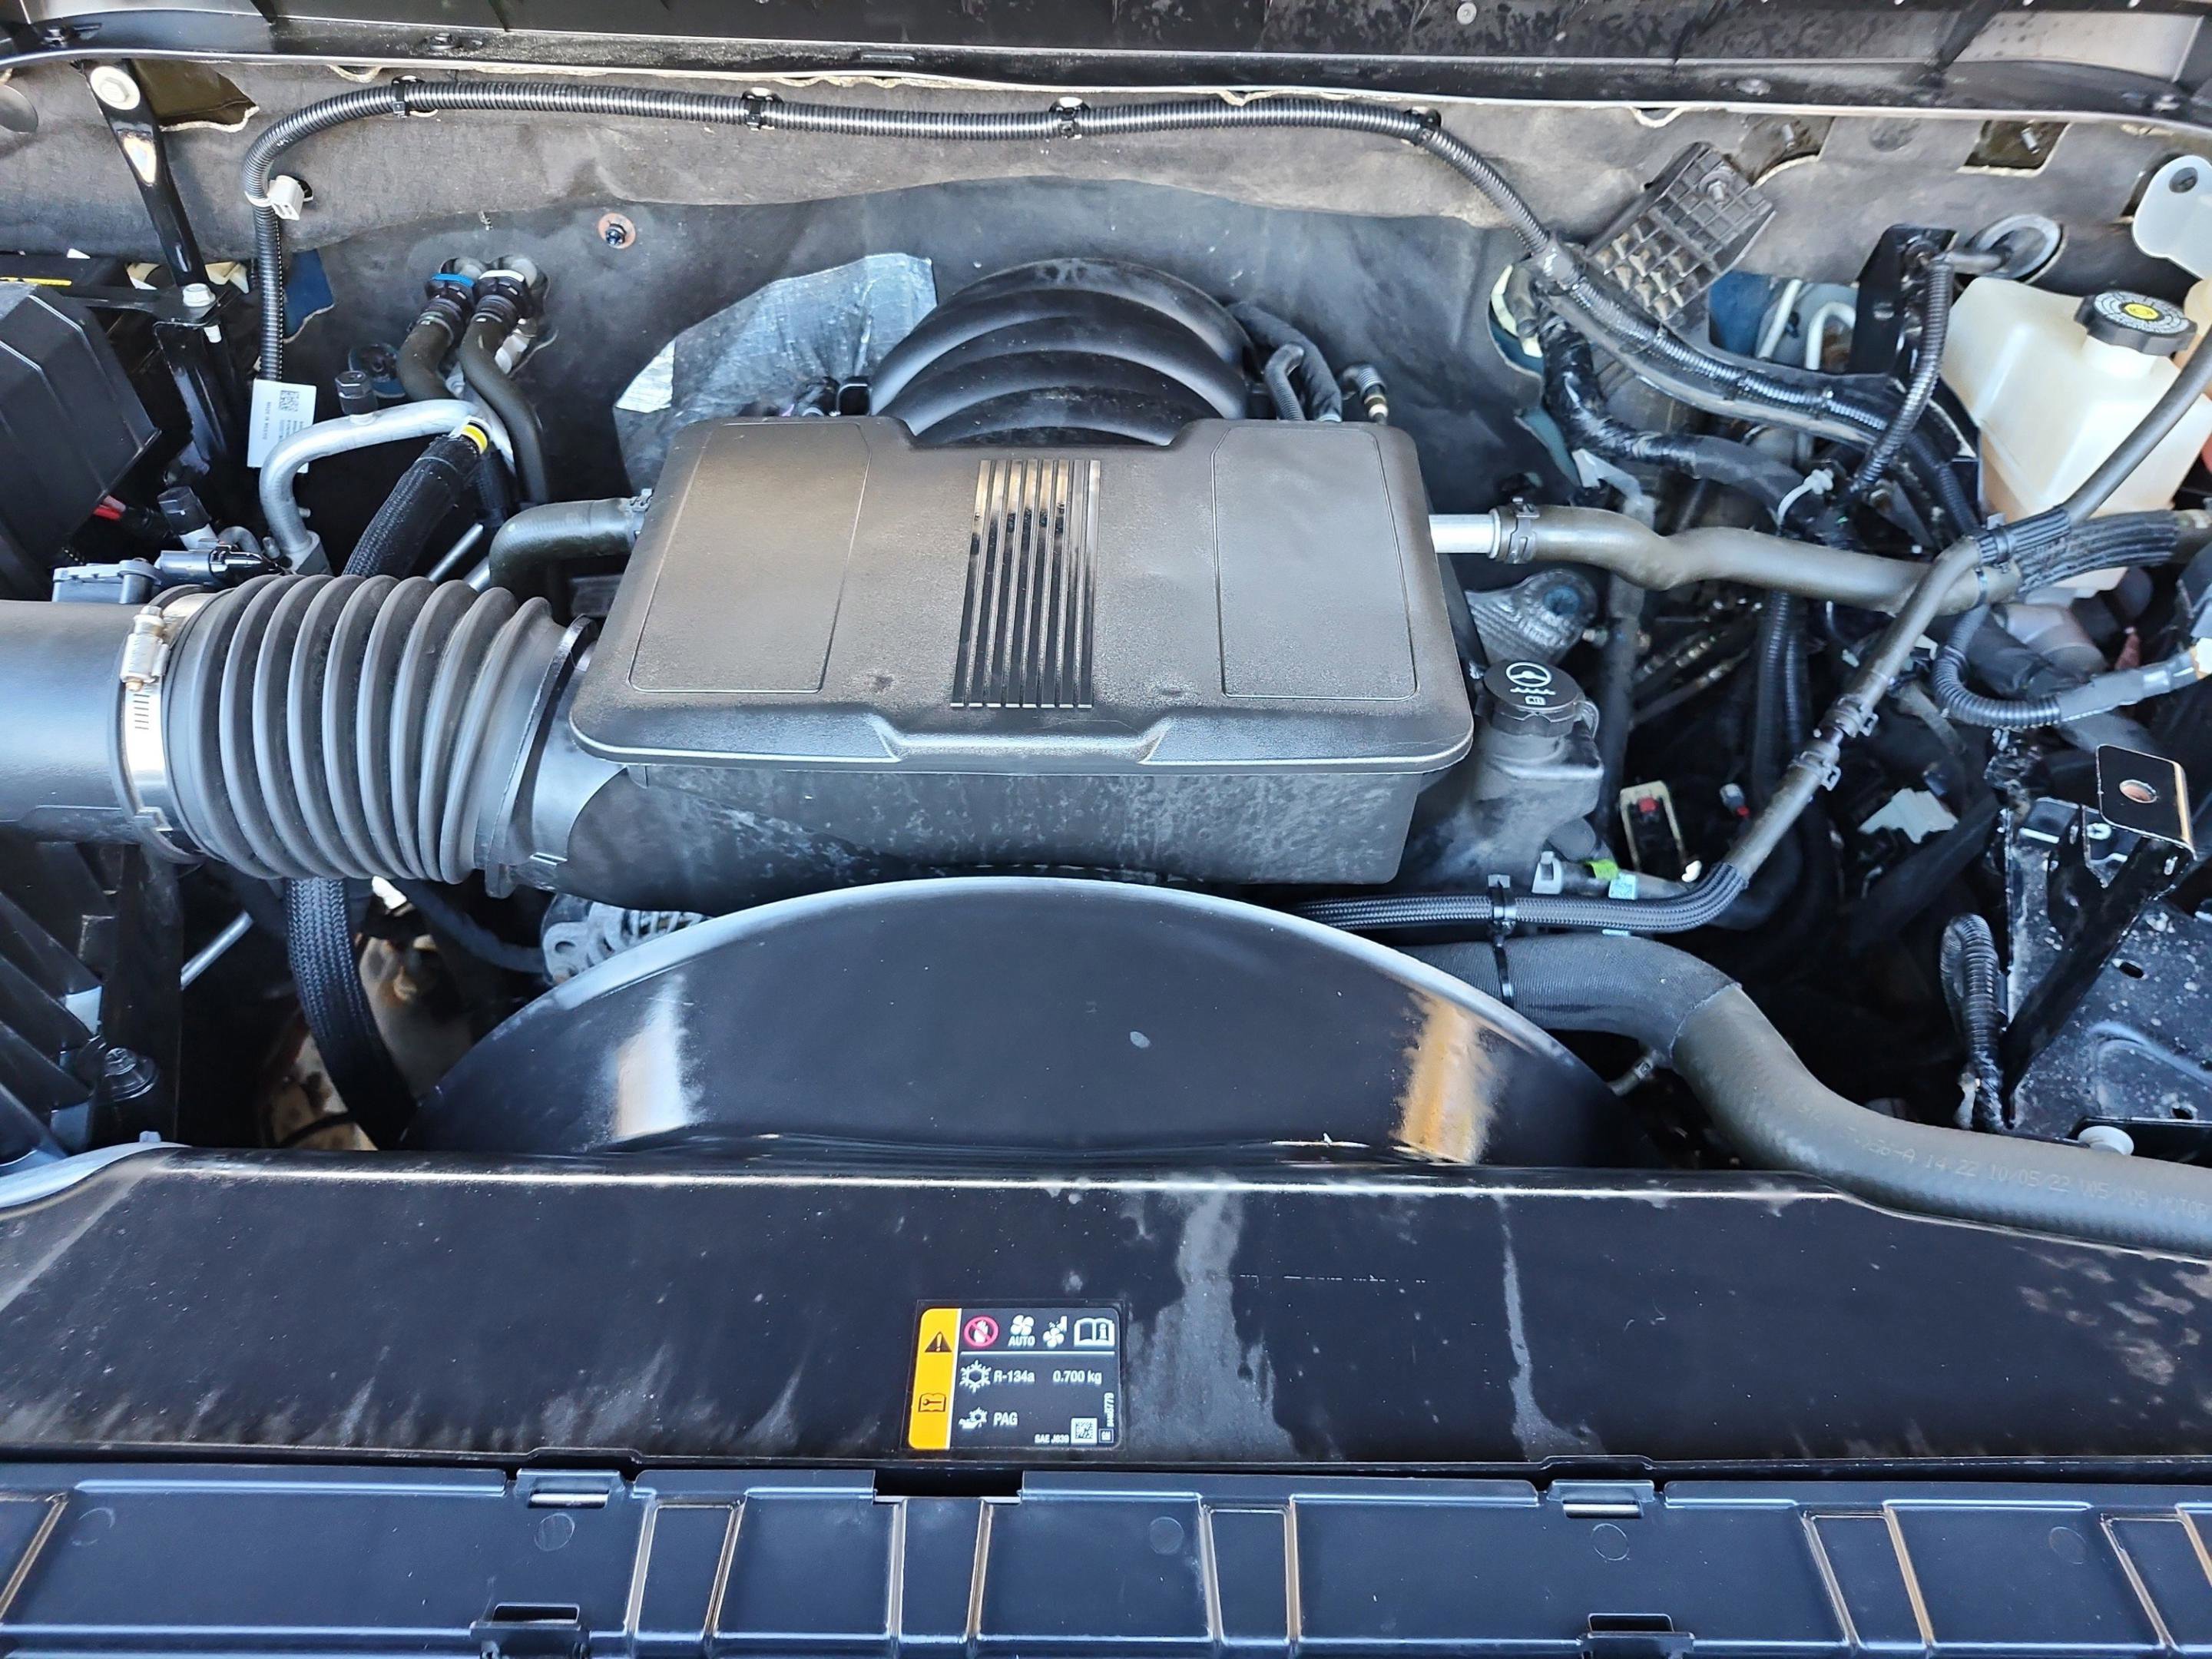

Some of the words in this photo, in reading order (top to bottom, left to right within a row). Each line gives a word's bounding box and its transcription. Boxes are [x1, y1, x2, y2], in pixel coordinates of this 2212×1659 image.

[1008, 1336, 1035, 1346] AUTO
[994, 1370, 1035, 1383] R-134a
[1052, 1370, 1085, 1383] 0.700
[1087, 1370, 1102, 1385] kg
[993, 1412, 1018, 1426] PAG
[1034, 1434, 1050, 1444] SAE
